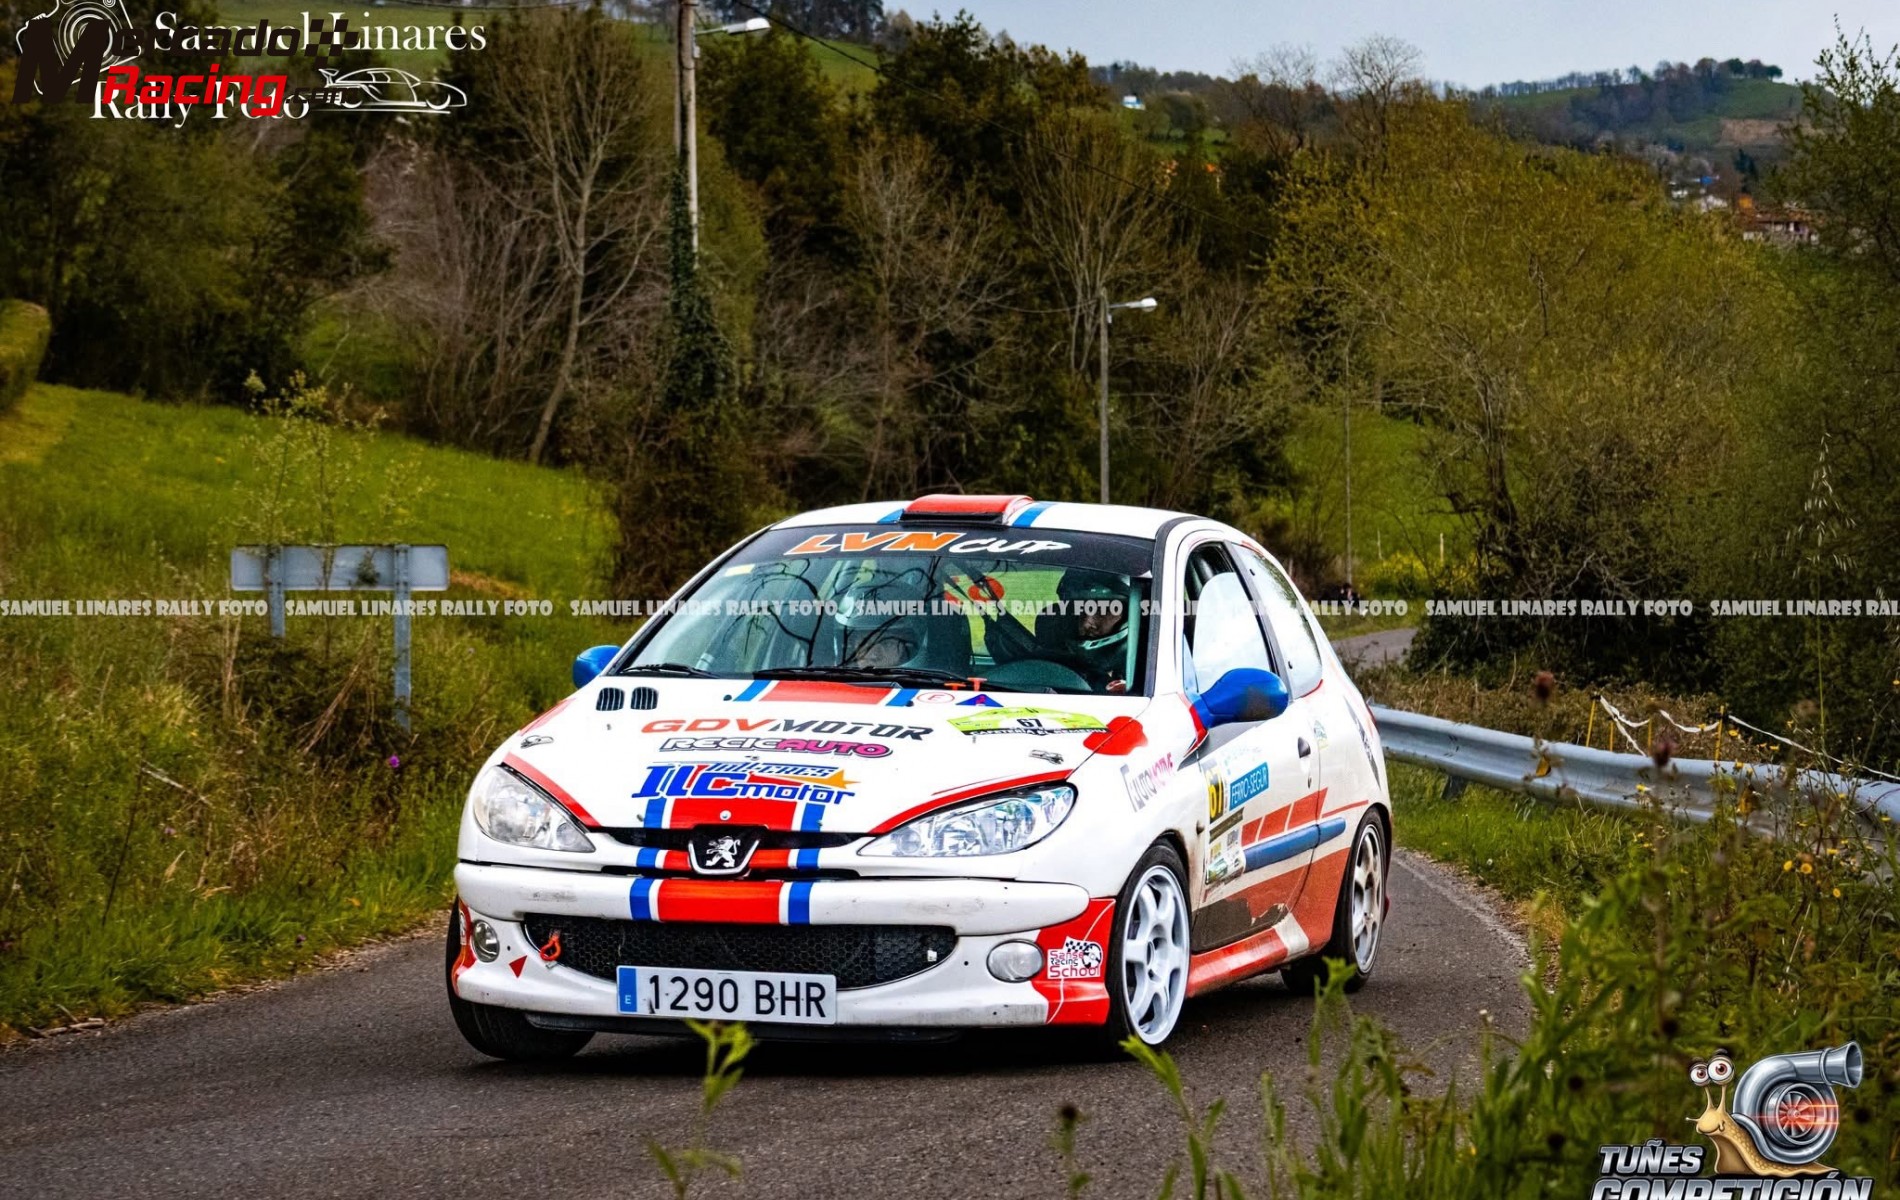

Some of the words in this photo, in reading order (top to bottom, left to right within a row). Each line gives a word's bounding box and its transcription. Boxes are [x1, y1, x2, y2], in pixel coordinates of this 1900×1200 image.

[784, 531, 967, 556] LVN
[1017, 718, 1044, 728] 67
[1050, 957, 1079, 967] Racing
[1049, 965, 1100, 978] School
[625, 994, 632, 1005] E
[649, 974, 739, 1014] 1290
[755, 979, 826, 1018] BHR
